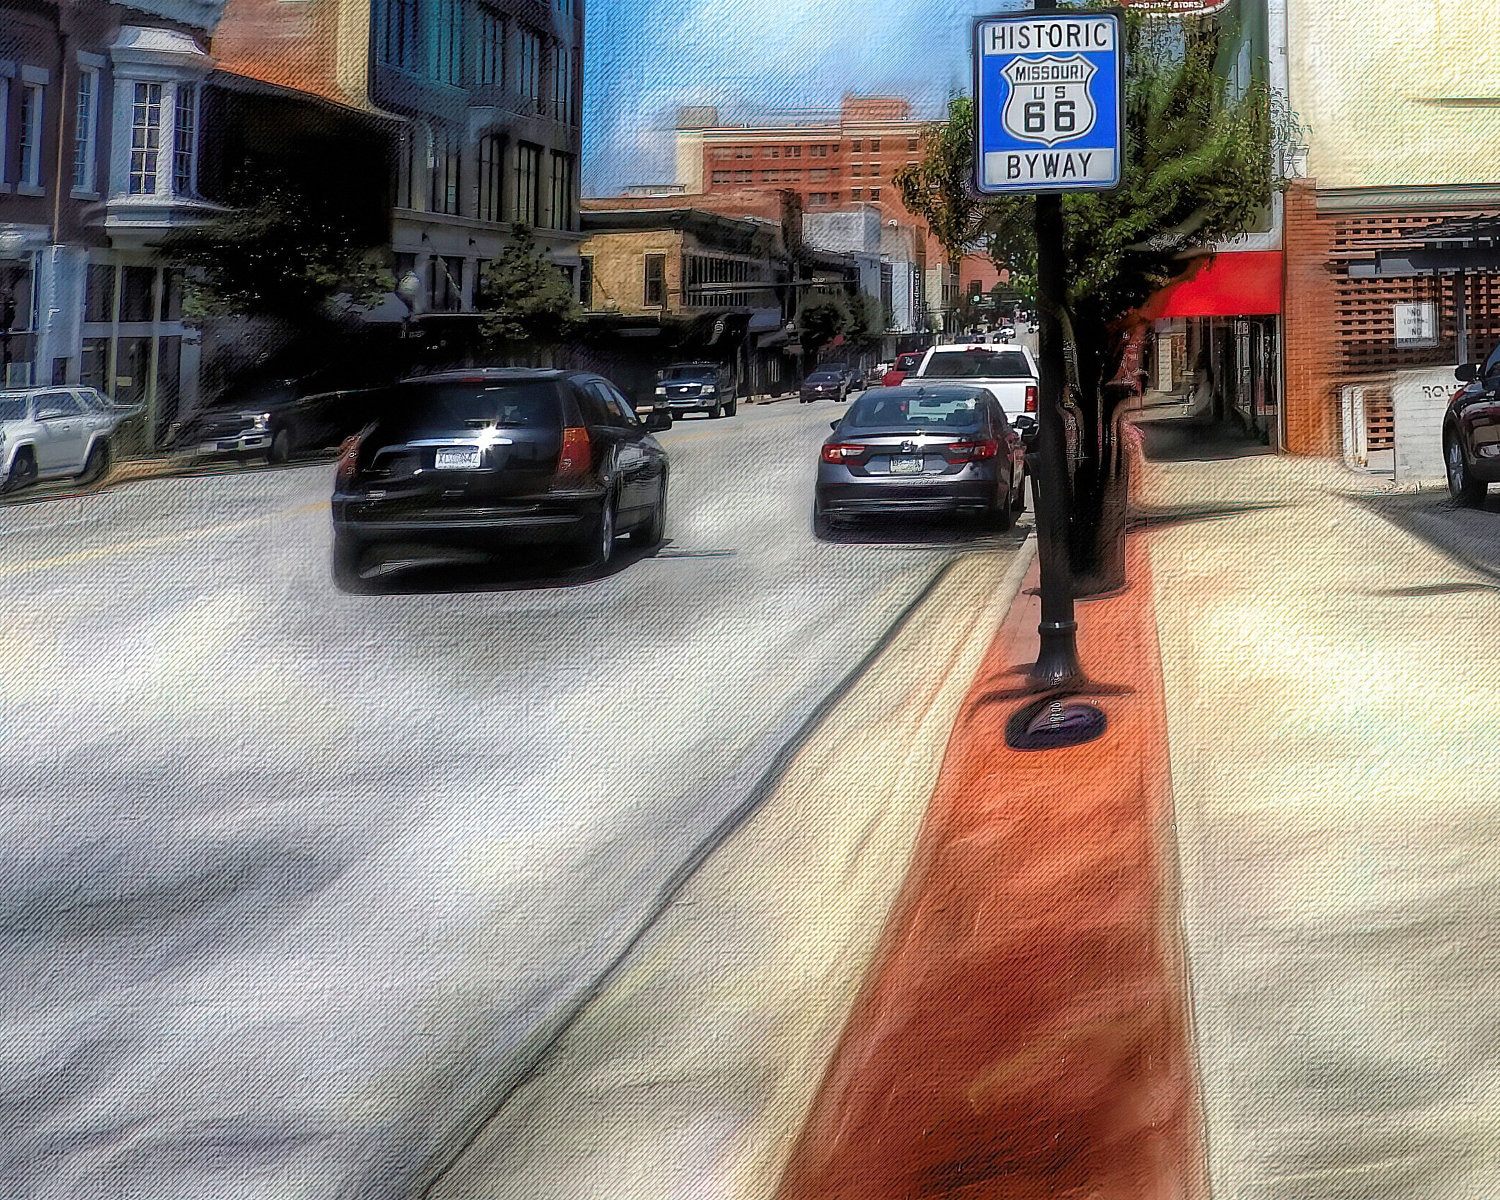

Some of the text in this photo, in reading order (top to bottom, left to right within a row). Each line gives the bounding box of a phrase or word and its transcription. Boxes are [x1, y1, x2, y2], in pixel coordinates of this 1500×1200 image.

[991, 23, 1107, 50] HISTORIC
[1015, 64, 1085, 81] MISSOURI
[1024, 101, 1076, 132] 66
[1007, 152, 1093, 179] BYWAY
